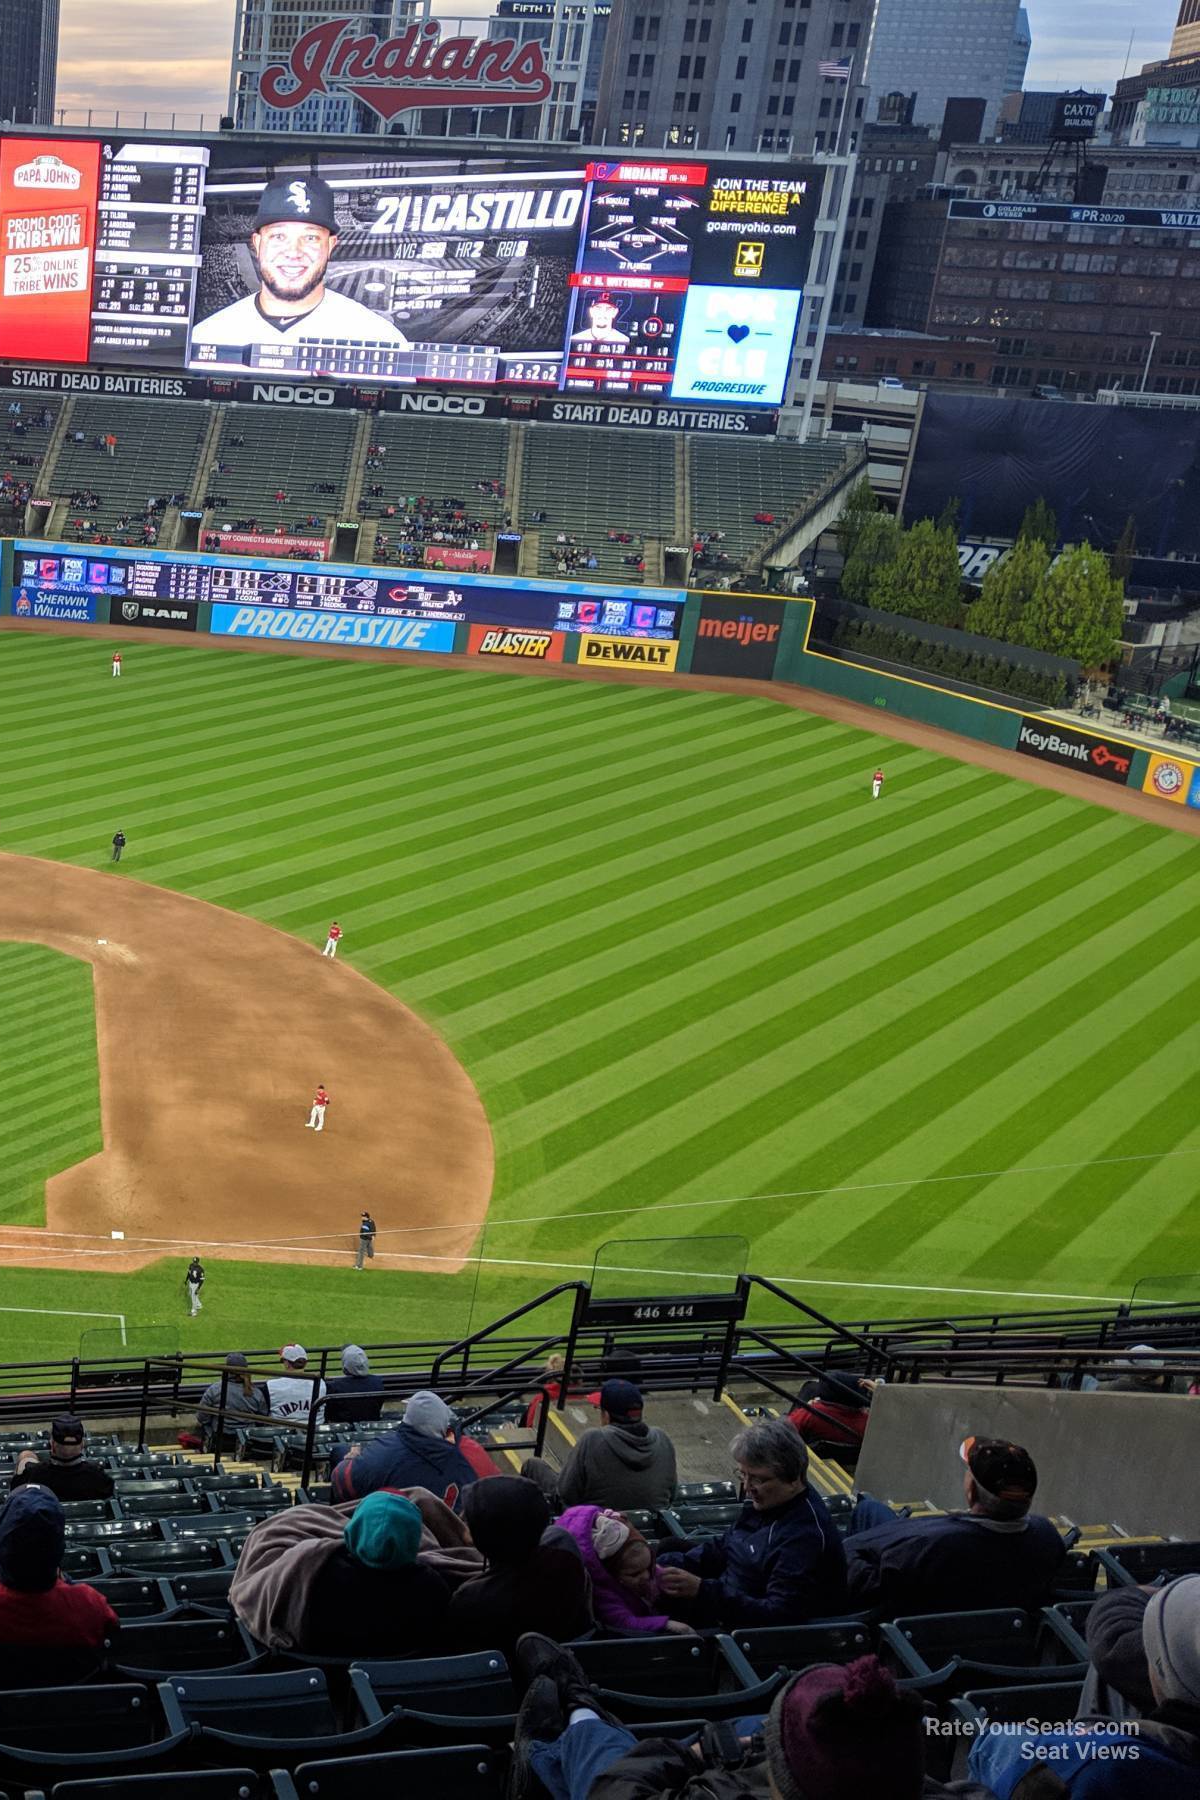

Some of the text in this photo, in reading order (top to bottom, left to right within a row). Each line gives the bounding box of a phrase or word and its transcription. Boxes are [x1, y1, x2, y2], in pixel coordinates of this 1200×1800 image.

[513, 3, 543, 13] FIFTH
[259, 15, 552, 112] Indians
[17, 168, 41, 183] PAPA
[619, 167, 668, 180] INDIANS
[713, 178, 807, 194] JOIN THE TEAM
[711, 189, 802, 205] THAT MAKES A
[370, 196, 414, 234] 21
[421, 190, 584, 231] CASTILLO
[709, 200, 790, 215] DIFFERENCE.
[7, 216, 47, 232] PROMO
[1081, 209, 1125, 223] PR 20/20
[706, 221, 797, 236] goarmyohio.com
[7, 226, 81, 250] TRIBEWIN
[394, 241, 517, 259] AVG HR 2 RBI
[43, 259, 80, 276] ONLINE
[13, 272, 79, 294] TRIBE WINS
[516, 364, 557, 381] 2 2 2
[12, 369, 187, 397] START DEAD BATTERIES.
[690, 380, 768, 396] PROGRESSIVE
[253, 384, 335, 406] NOCO
[400, 393, 486, 415] NOCO
[552, 403, 750, 431] START DEAD BATTERIES.
[232, 535, 265, 544] CONNECTS
[265, 538, 282, 546] MORE
[42, 560, 58, 579] C
[64, 559, 82, 569] FOX
[64, 573, 81, 583] GO
[93, 564, 106, 582] C
[35, 592, 89, 607] SHERWIN
[606, 602, 627, 611] FOX
[34, 604, 90, 620] WILLIAMS.
[142, 606, 188, 620] RAM
[580, 604, 596, 621] C
[637, 608, 653, 626] C
[227, 607, 432, 648] PROGRESSIVE
[605, 616, 625, 625] GO
[699, 614, 780, 645] meijer
[479, 631, 551, 658] BLASTER
[1019, 727, 1090, 762] KeyBank
[634, 1305, 694, 1319] 446 444
[279, 1401, 313, 1417] INDIA
